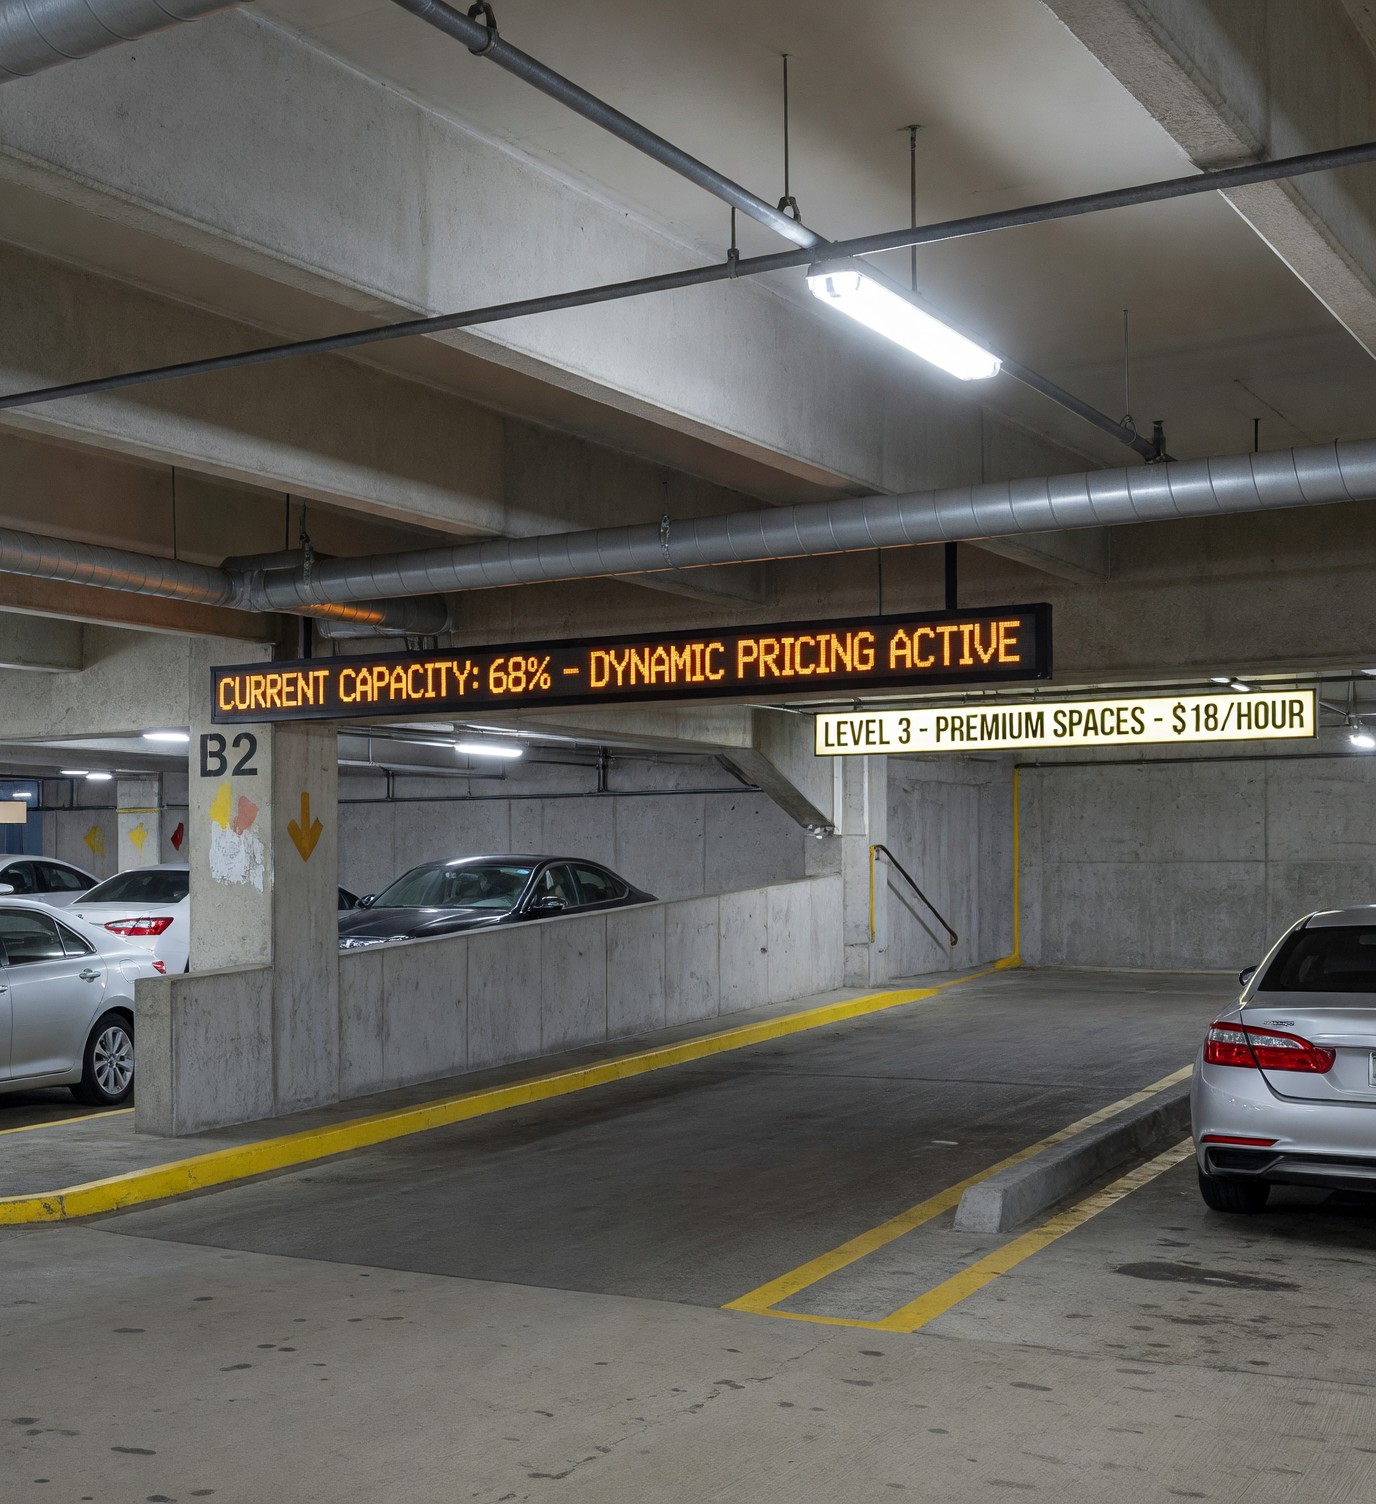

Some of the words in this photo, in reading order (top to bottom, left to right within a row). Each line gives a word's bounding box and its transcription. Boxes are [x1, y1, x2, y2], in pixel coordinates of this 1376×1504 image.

[219, 670, 329, 711] CURRENT
[339, 660, 479, 703] CAPACITY:
[489, 655, 551, 694] 68%
[590, 642, 724, 688] DYNAMIC
[737, 631, 875, 678] PRICING
[889, 620, 1020, 669] ACTIVE
[825, 719, 890, 747] LEVEL
[898, 717, 911, 744] 3
[936, 711, 1044, 742] PREMIUM
[1053, 707, 1145, 738] SPACES
[1172, 699, 1304, 735] $18/HOUR
[200, 733, 258, 777] B2
